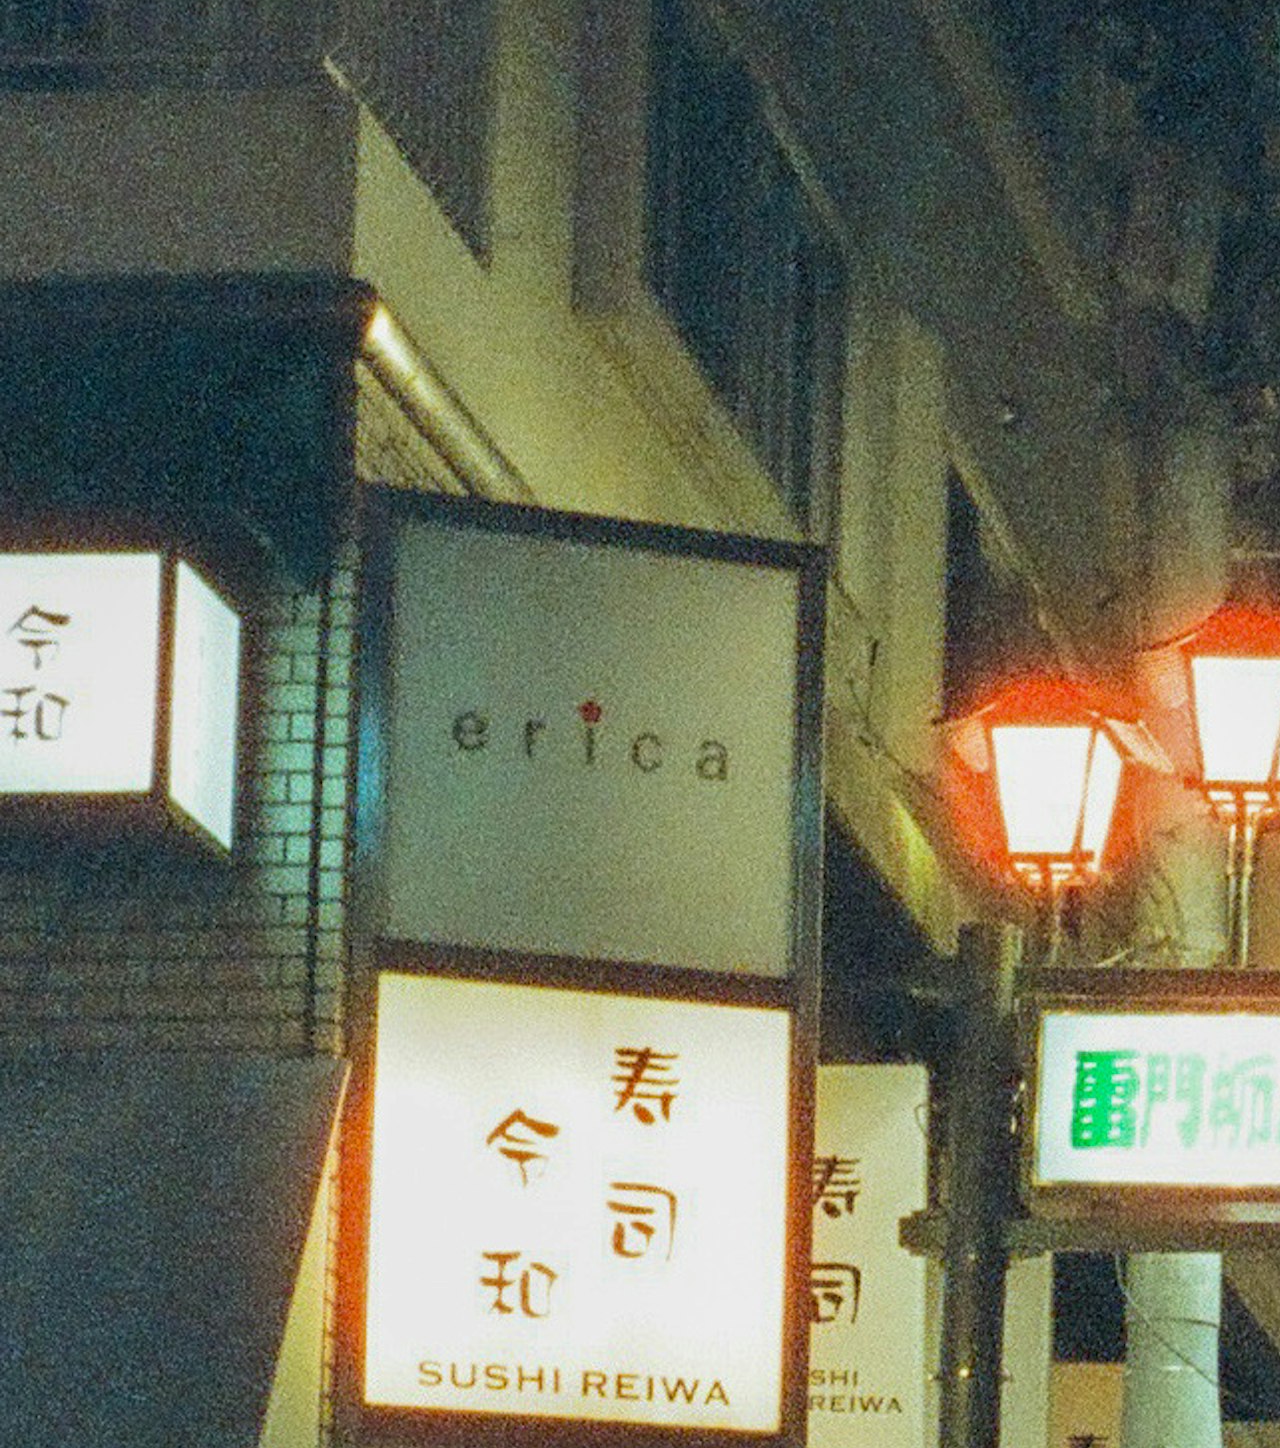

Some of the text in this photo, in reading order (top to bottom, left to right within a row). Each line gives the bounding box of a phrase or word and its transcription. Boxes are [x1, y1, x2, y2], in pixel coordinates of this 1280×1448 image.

[450, 699, 731, 784] erica
[478, 1109, 562, 1321] 令和
[608, 1048, 683, 1263] 寿司
[811, 1154, 861, 1326] 寿司
[418, 1359, 732, 1408] SUSHI REIWA
[809, 1371, 859, 1387] SHI
